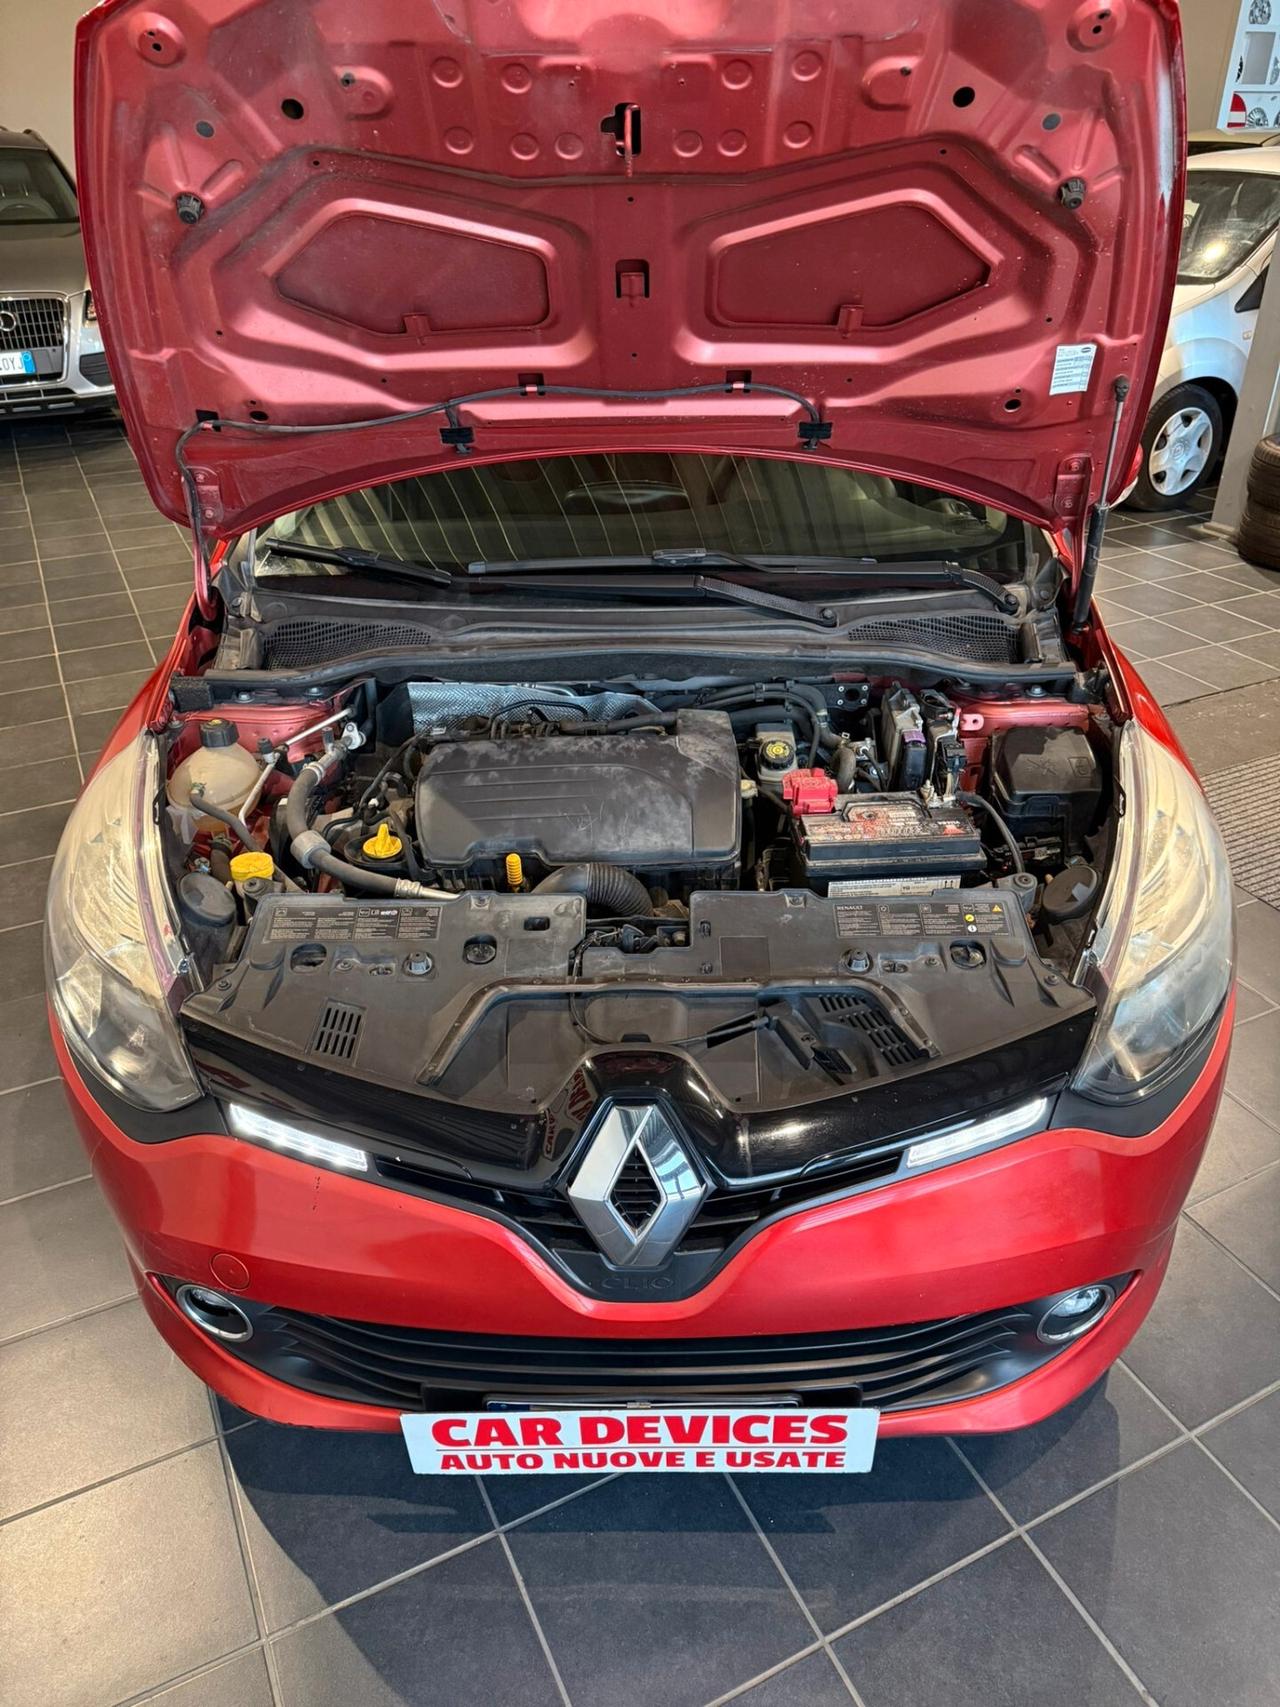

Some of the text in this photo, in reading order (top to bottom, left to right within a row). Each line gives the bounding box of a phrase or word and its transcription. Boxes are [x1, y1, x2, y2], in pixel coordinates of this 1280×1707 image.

[0, 357, 24, 371] 0YJ
[601, 1276, 674, 1290] CLIO
[432, 1414, 848, 1447] CAR DEVICES
[441, 1451, 843, 1471] AUTO NUOVE E USATE
